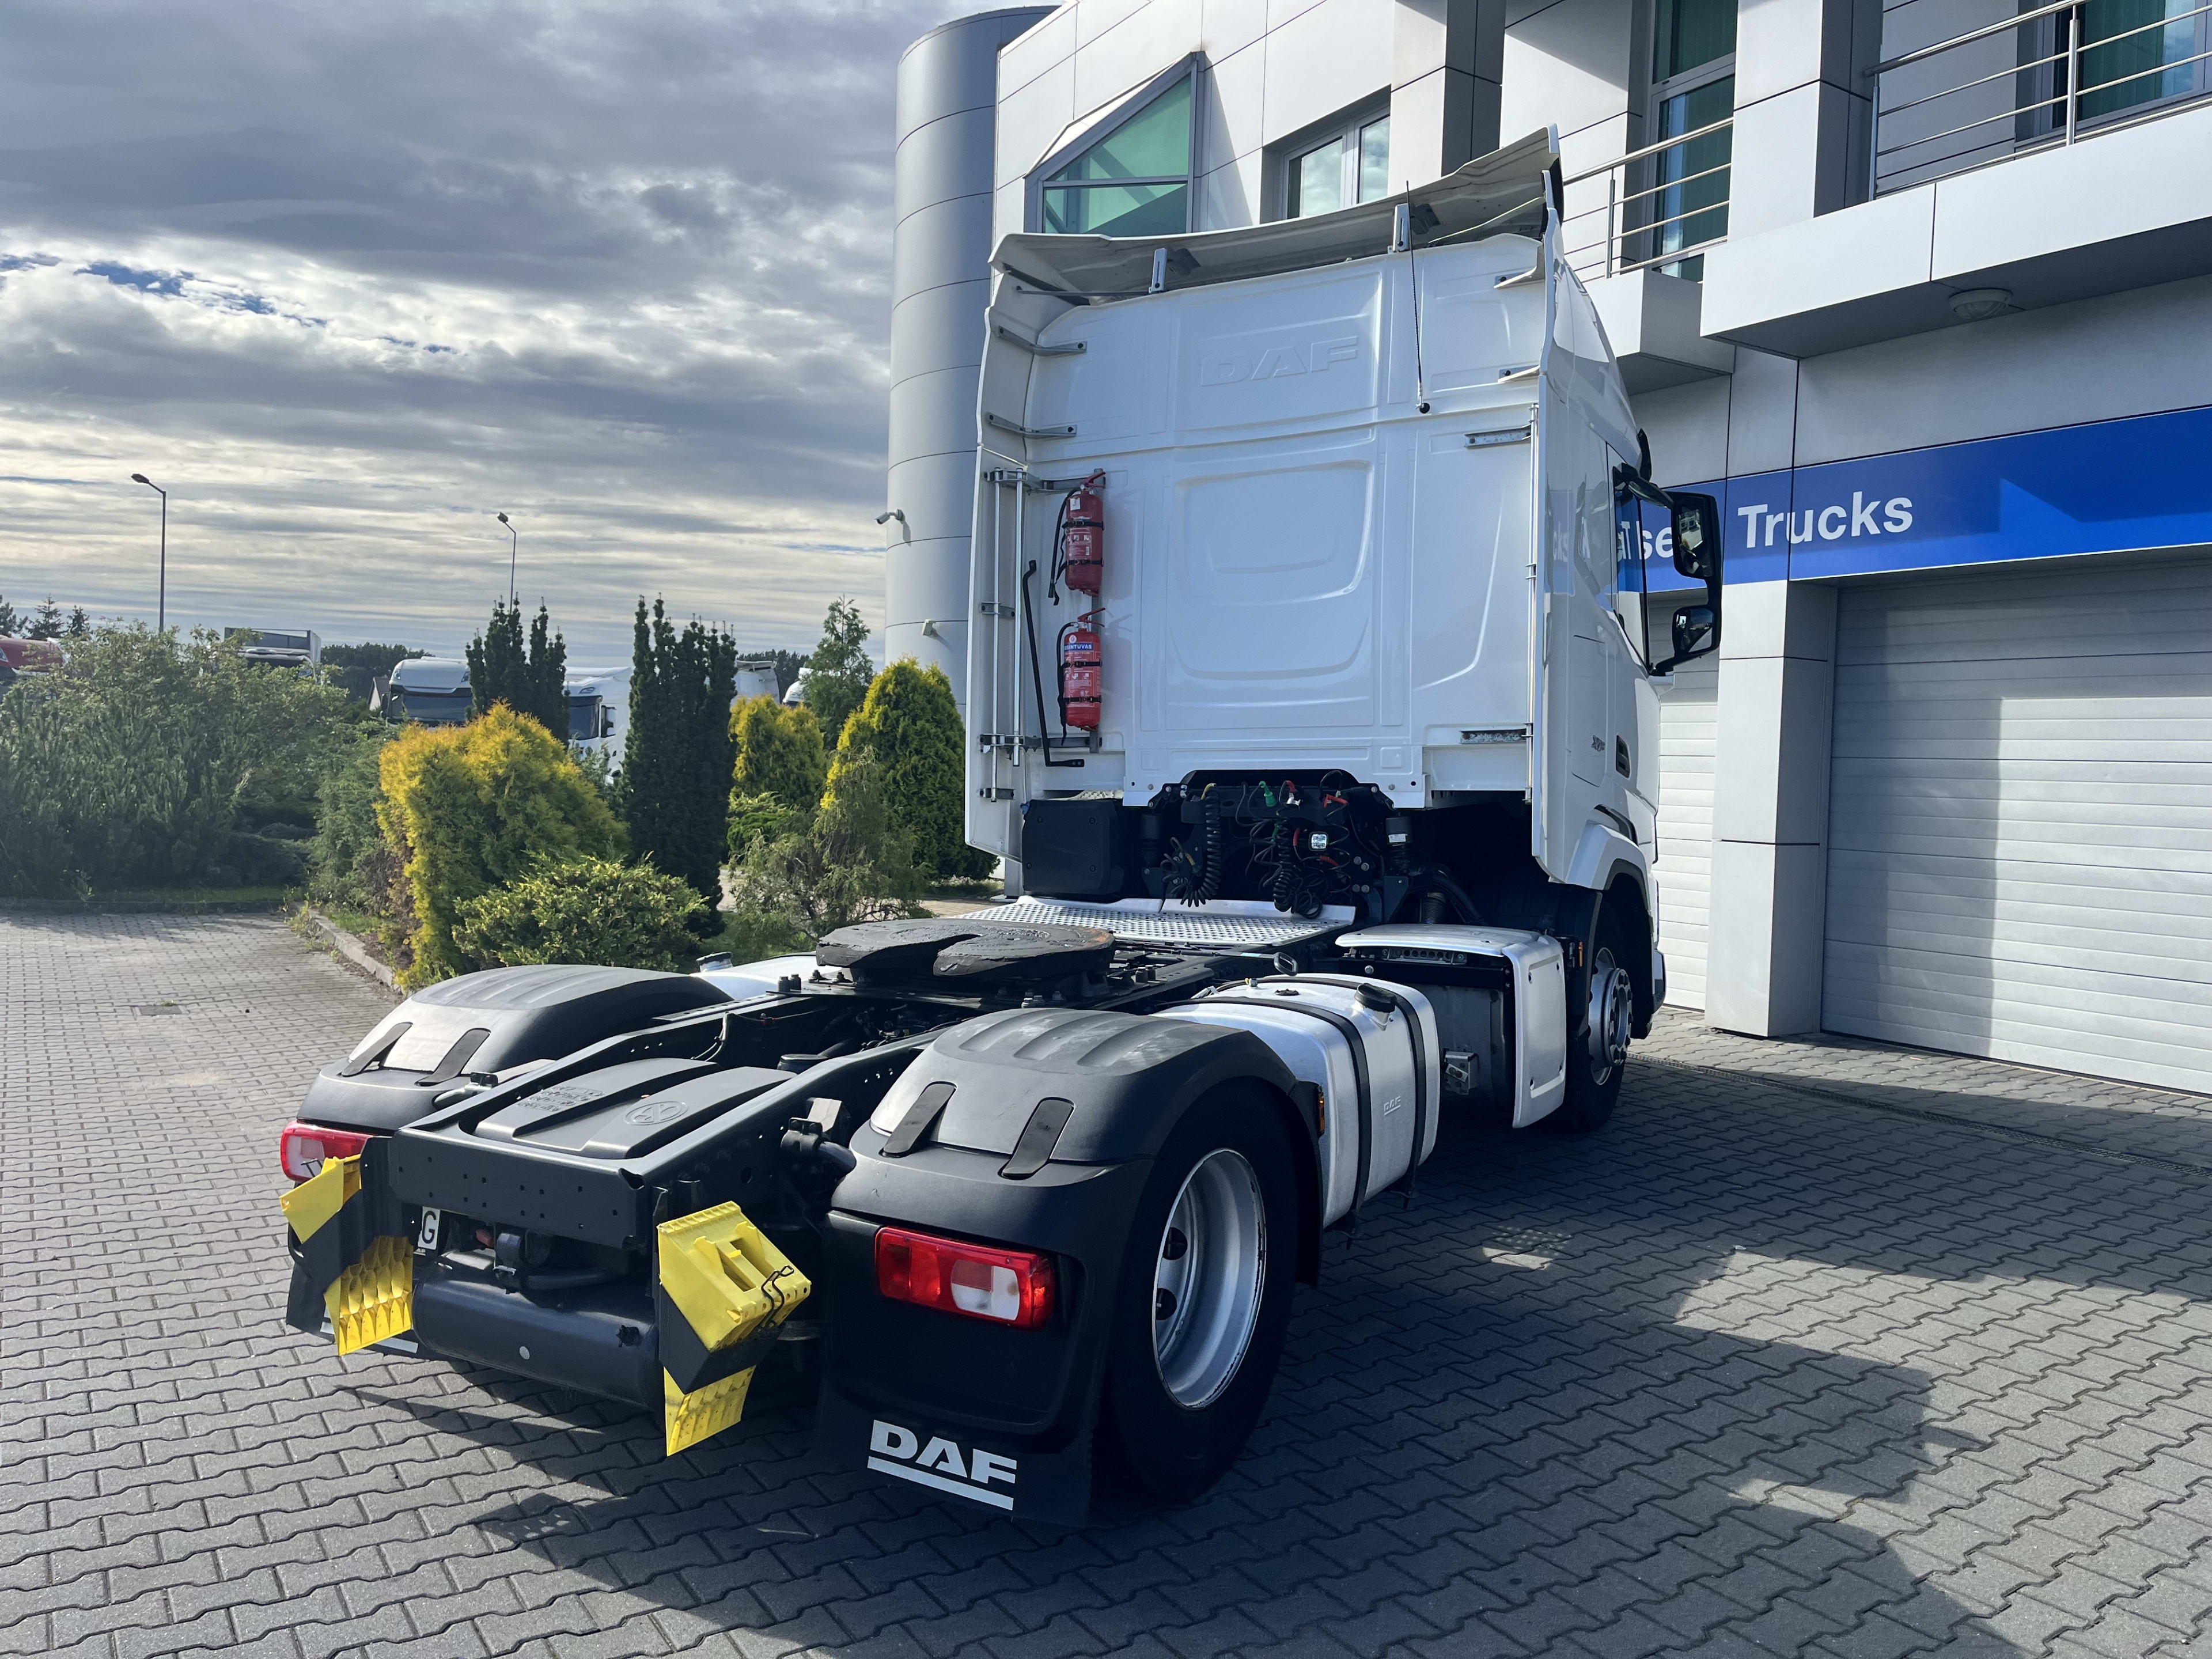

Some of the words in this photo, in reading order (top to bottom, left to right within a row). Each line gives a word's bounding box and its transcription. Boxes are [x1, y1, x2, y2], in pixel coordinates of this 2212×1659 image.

[1201, 336, 1358, 387] DAF
[1738, 491, 1913, 548] Trucks
[870, 1419, 1017, 1484] DAF
